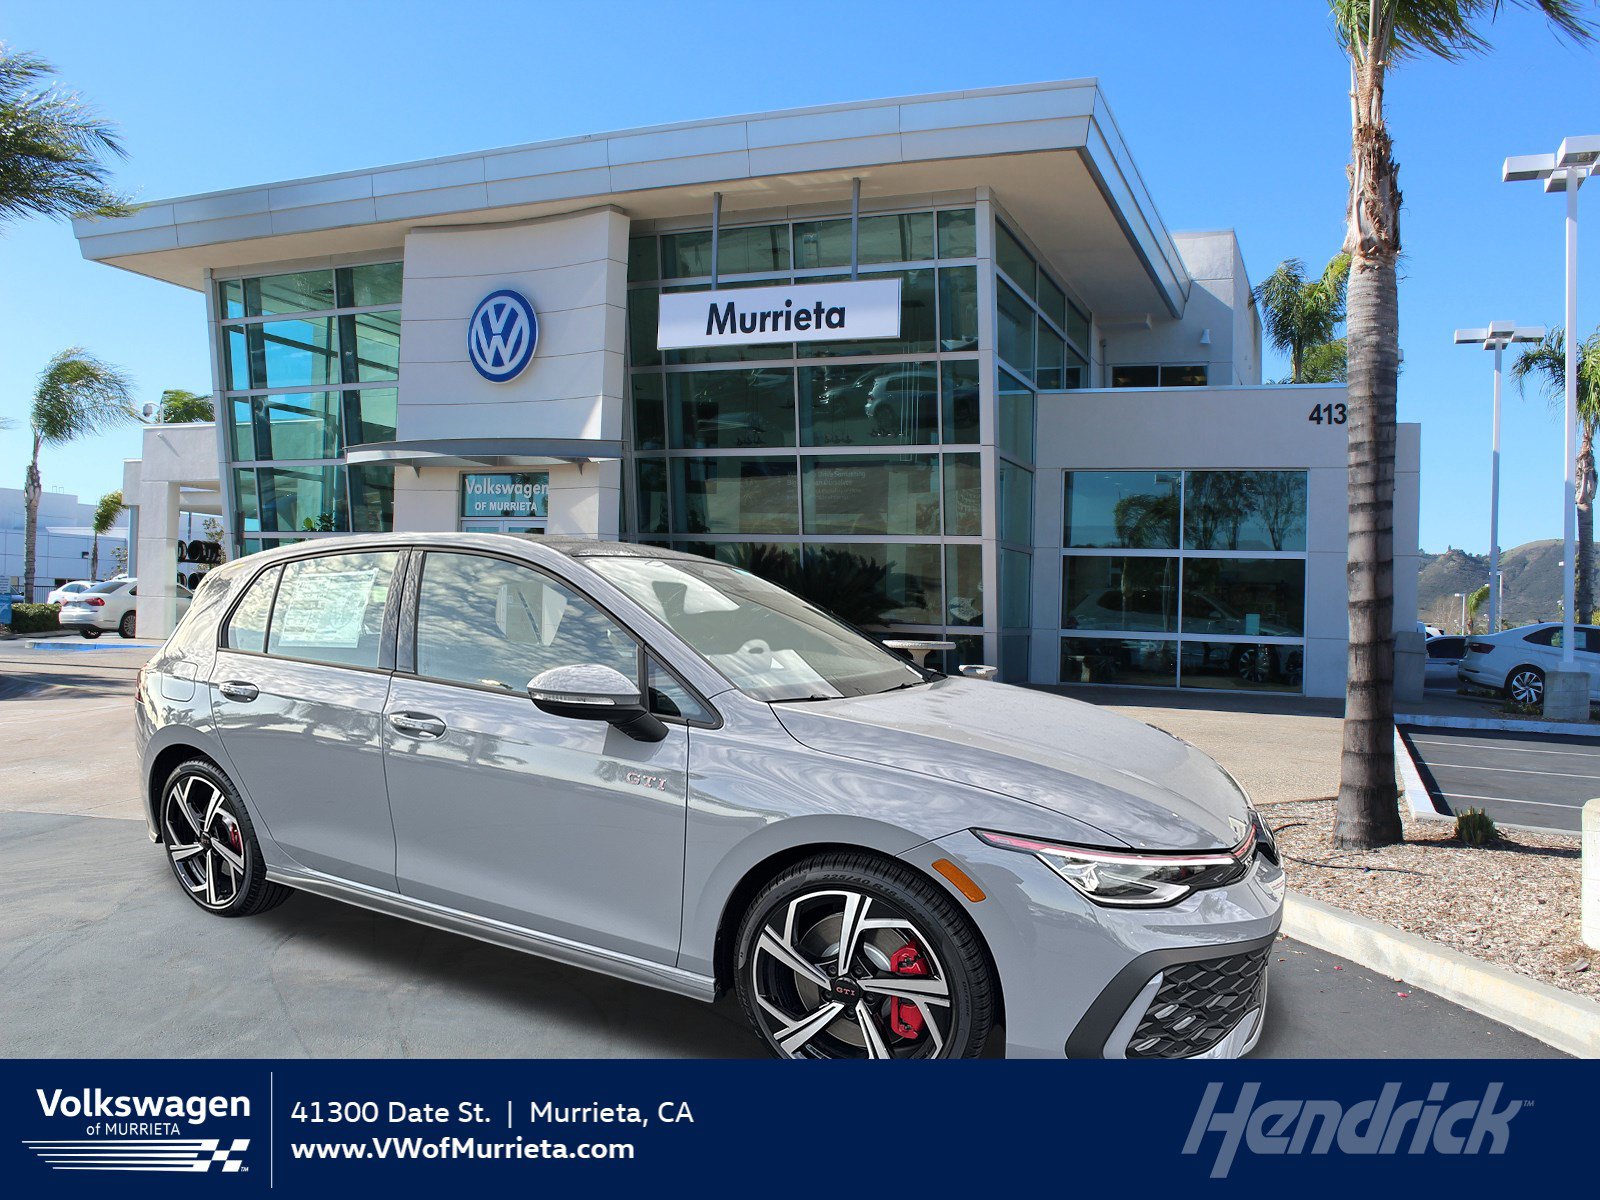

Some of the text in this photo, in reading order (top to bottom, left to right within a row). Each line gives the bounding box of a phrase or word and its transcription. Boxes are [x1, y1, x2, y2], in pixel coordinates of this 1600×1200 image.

[706, 299, 846, 336] Murrieta
[465, 478, 549, 498] Volkswagen
[474, 502, 538, 511] OF MURRIETA
[625, 771, 667, 791] GTI
[836, 986, 855, 996] GTI
